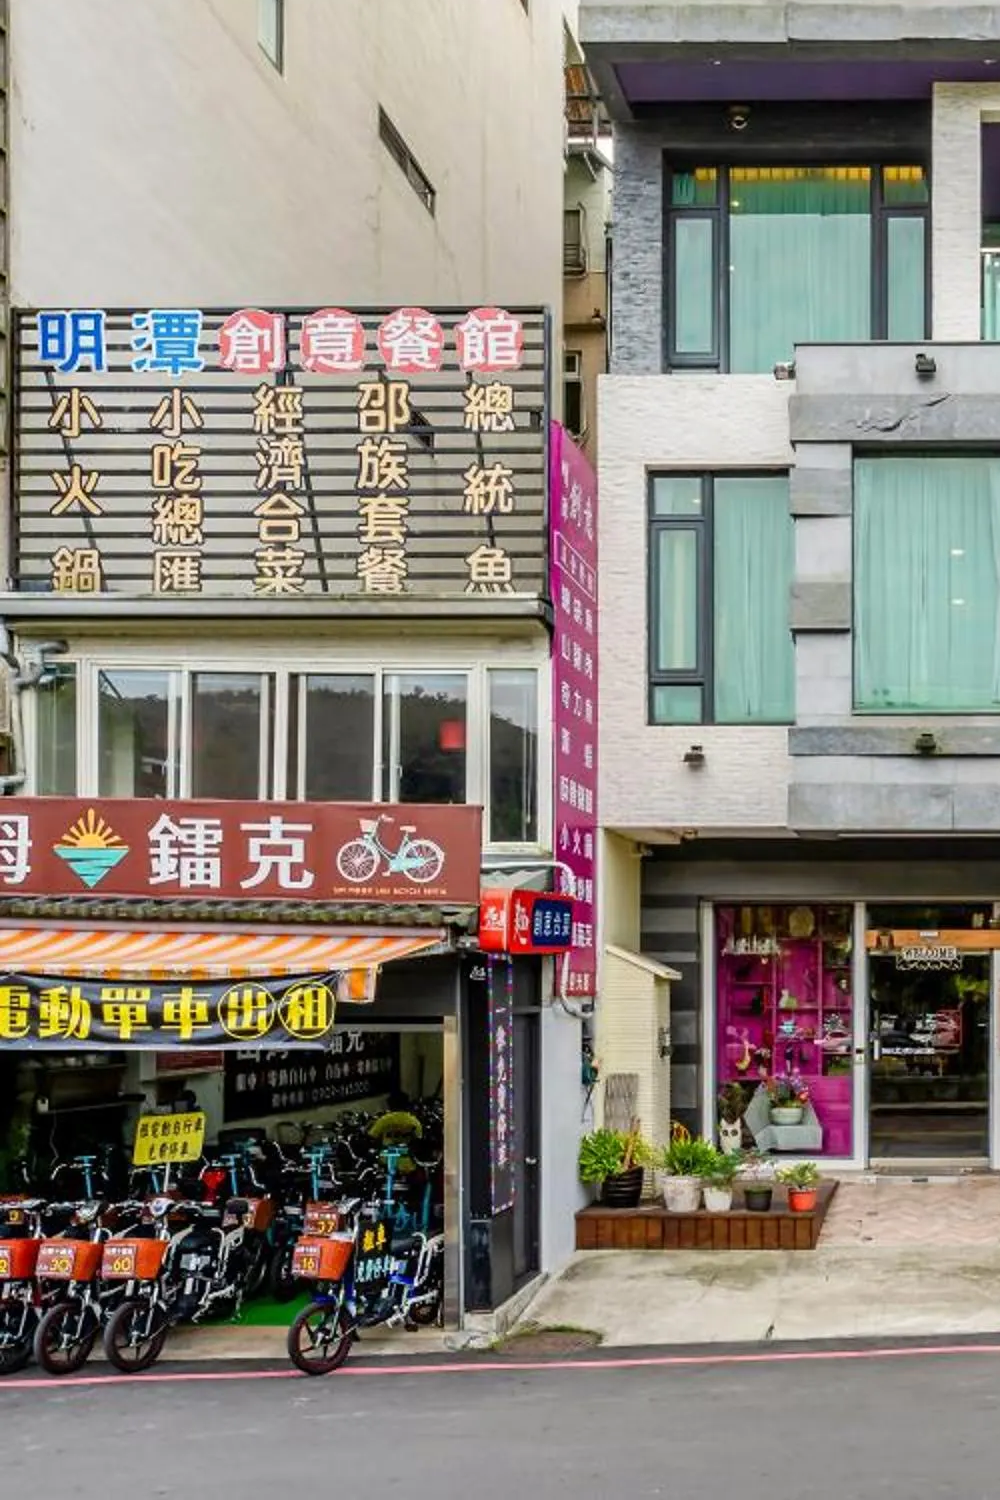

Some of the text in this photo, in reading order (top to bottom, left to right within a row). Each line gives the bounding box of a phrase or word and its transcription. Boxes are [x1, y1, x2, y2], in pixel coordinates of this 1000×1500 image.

[37, 309, 523, 376] 明潭創意餐館
[49, 387, 103, 593] 小火鍋
[150, 387, 203, 593] 小吃總匯
[252, 383, 304, 593] 經濟合菜
[356, 380, 410, 593] 邵族套餐
[463, 383, 515, 593] 總統魚
[147, 813, 315, 889] 鐳克
[901, 947, 956, 960] WELCOME
[0, 982, 334, 1040] 電動單車出租
